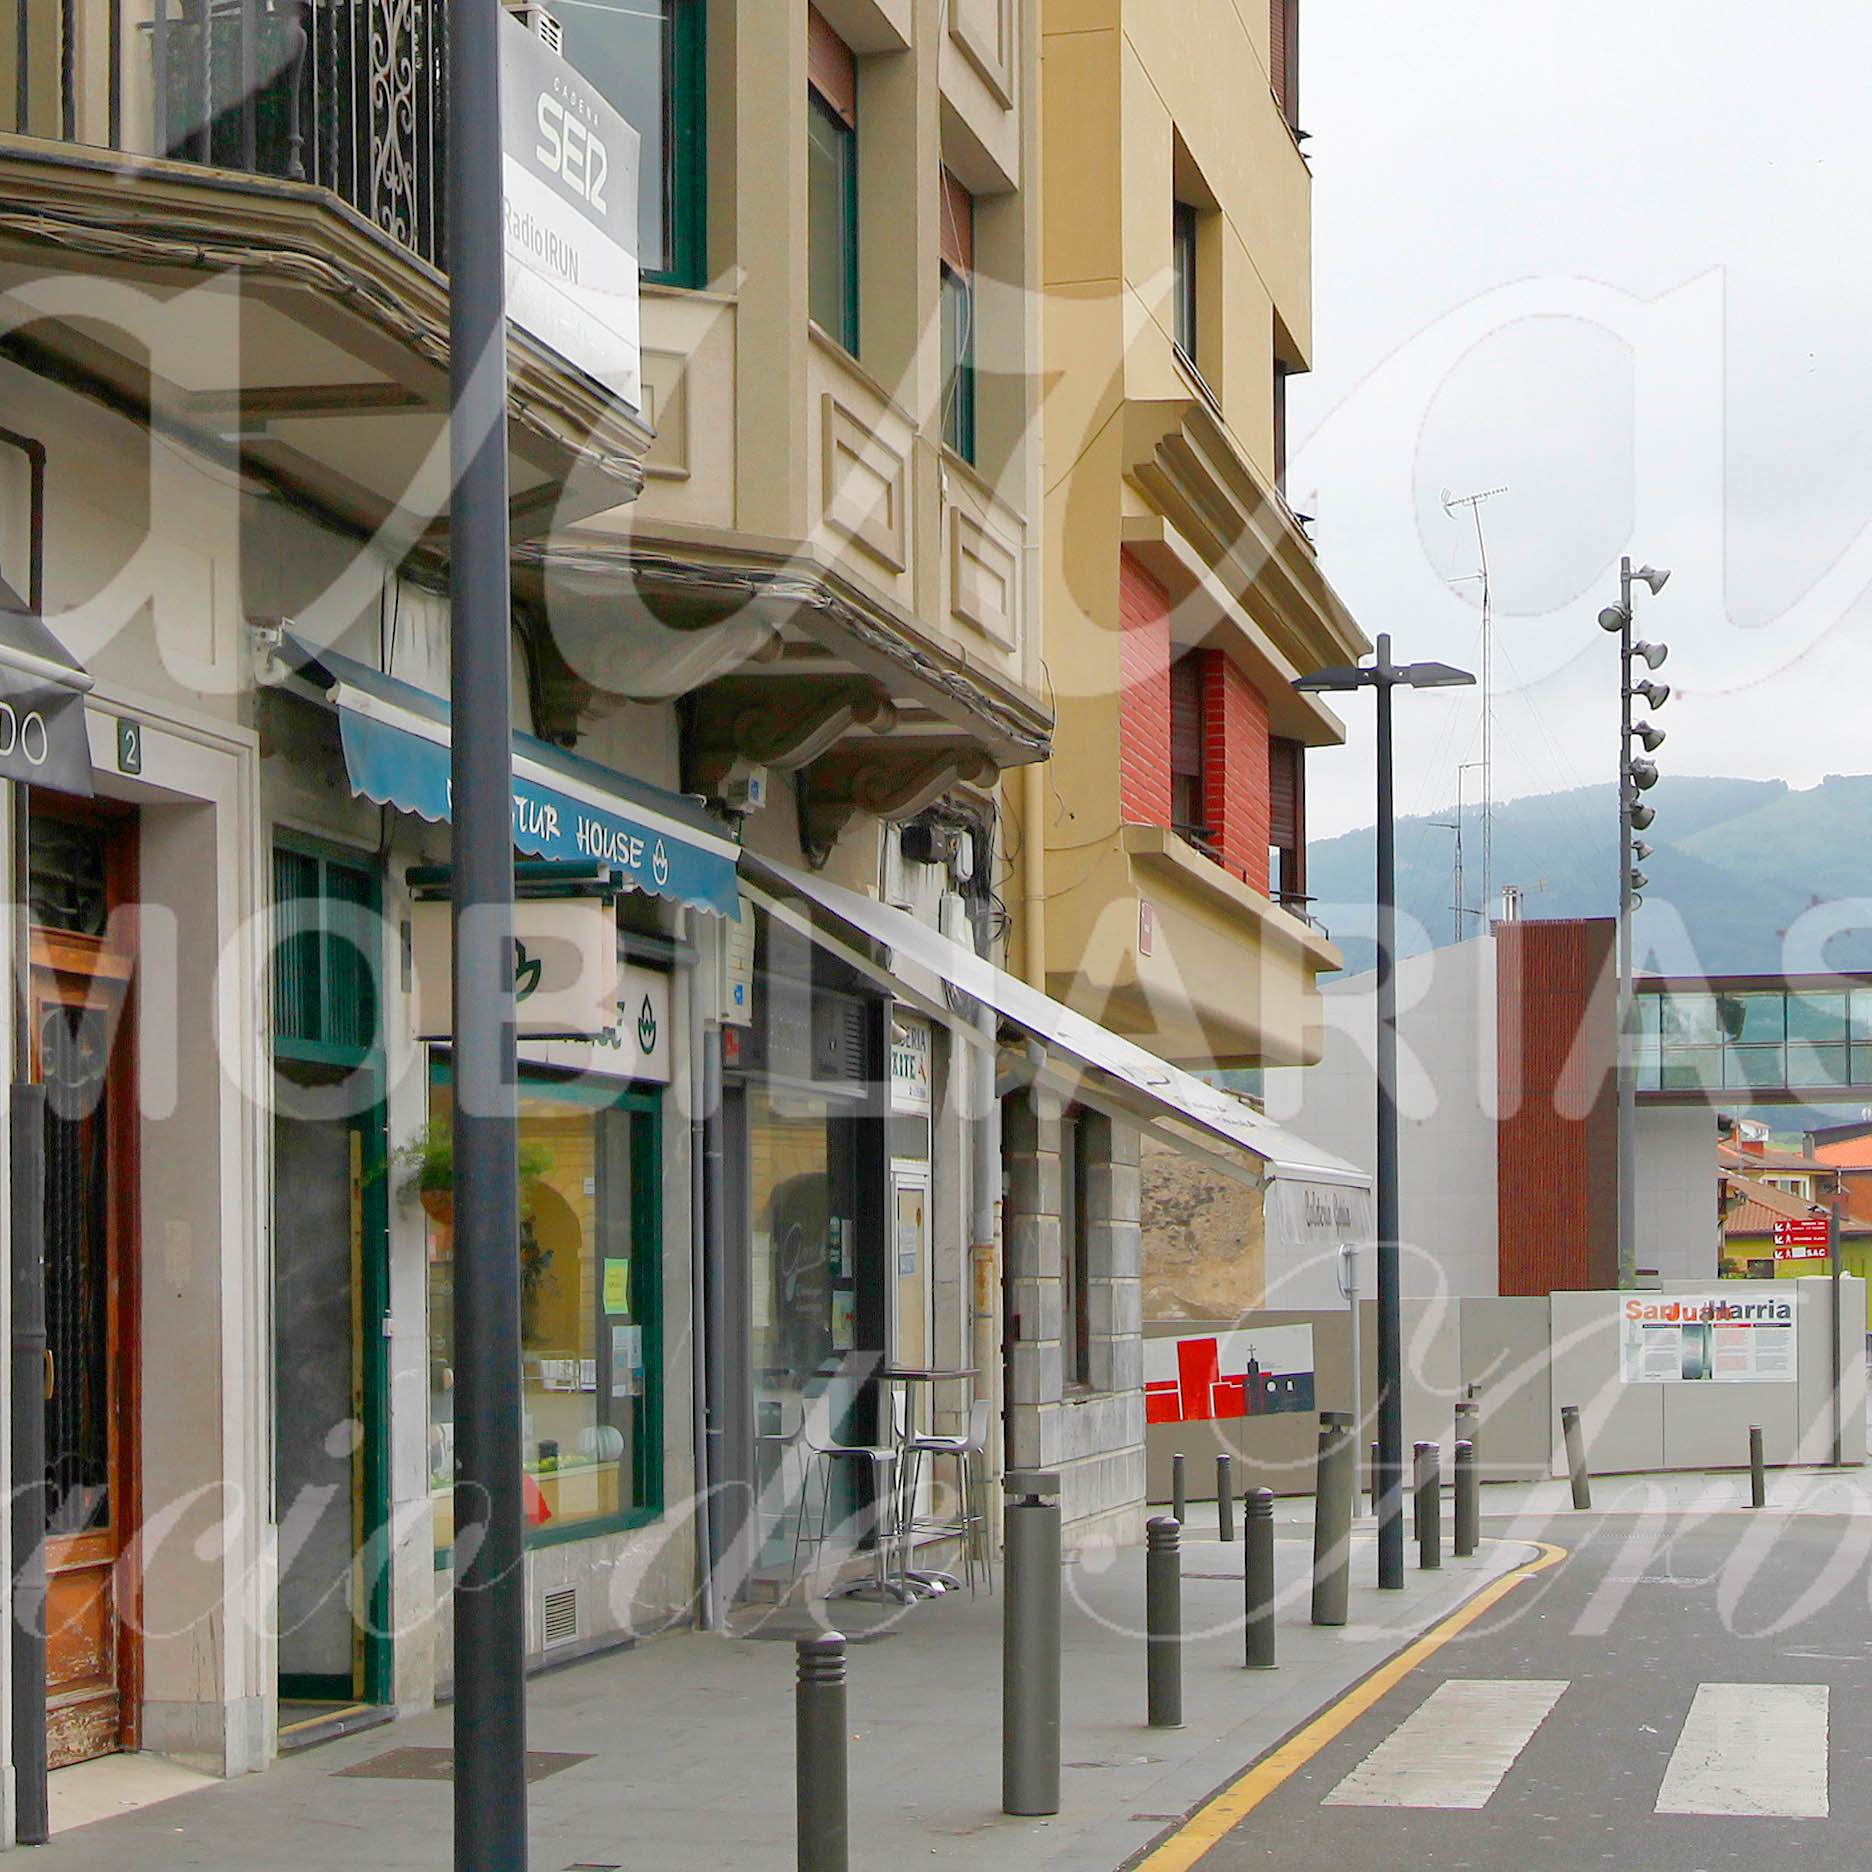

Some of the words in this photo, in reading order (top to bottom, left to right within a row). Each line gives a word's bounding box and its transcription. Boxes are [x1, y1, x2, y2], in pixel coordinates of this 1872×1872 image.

[553, 77, 599, 128] CADENA
[536, 92, 607, 216] SER
[124, 729, 138, 766] 2
[575, 814, 646, 870] HOUSE
